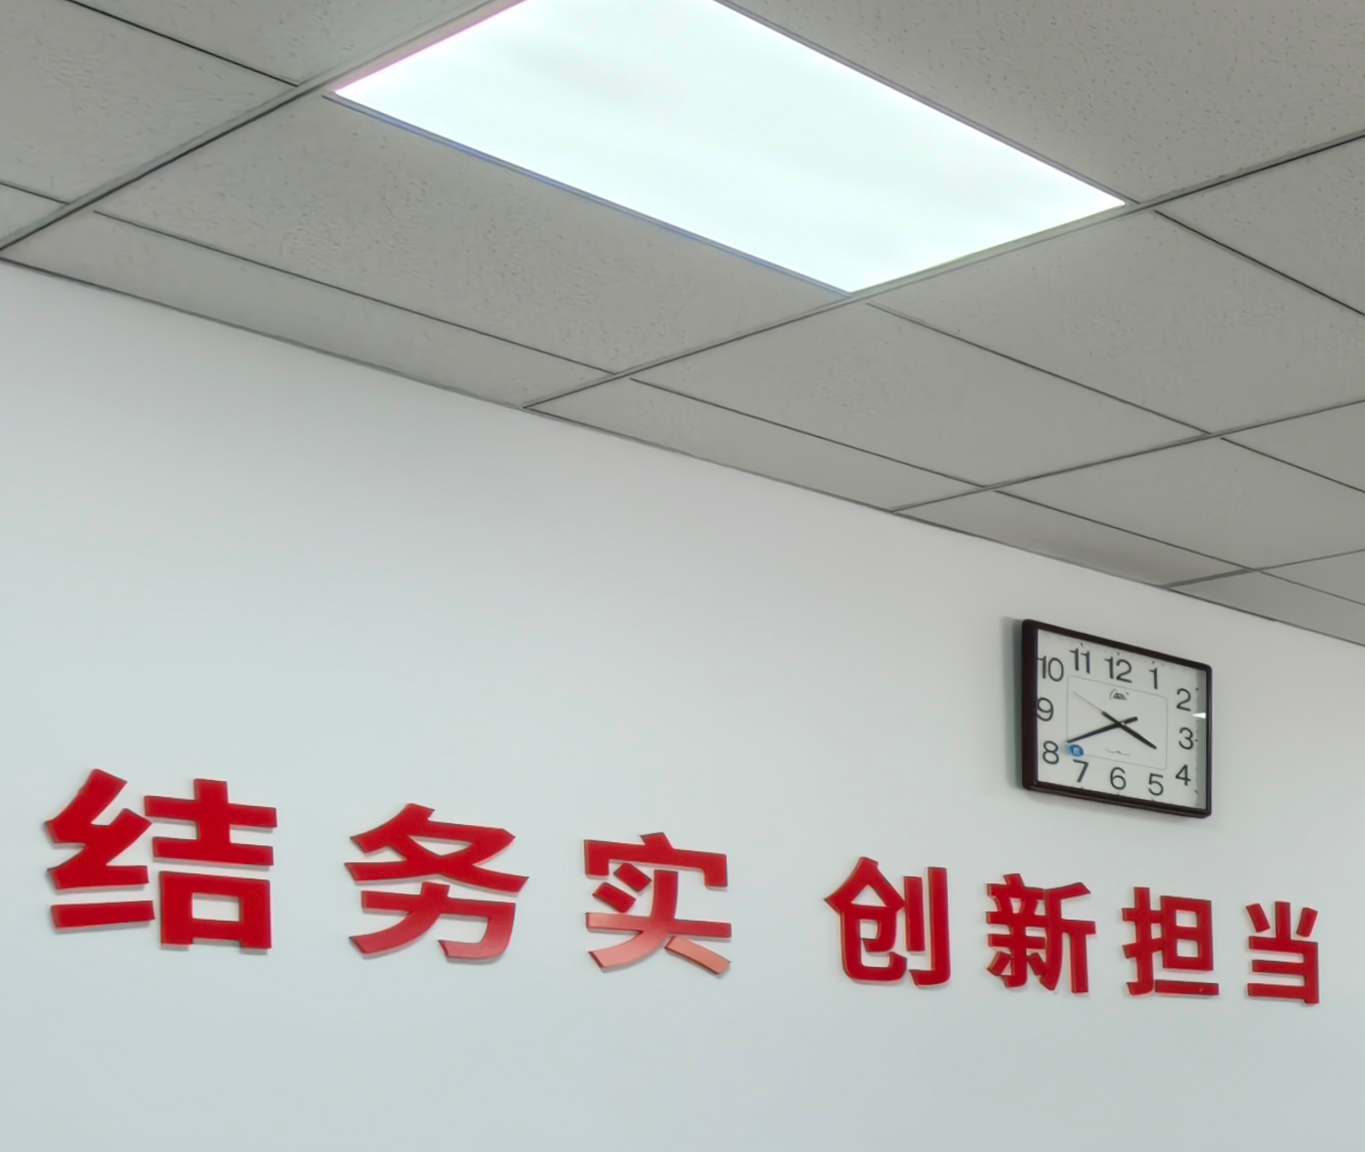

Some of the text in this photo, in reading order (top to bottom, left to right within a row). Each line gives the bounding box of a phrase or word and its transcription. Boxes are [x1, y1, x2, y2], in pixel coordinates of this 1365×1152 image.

[1037, 655, 1064, 682] 10
[1070, 648, 1091, 674] 11
[1104, 656, 1132, 684] 12
[1149, 667, 1159, 690] 1
[1036, 697, 1054, 722] 9
[1176, 688, 1191, 711] 2
[1178, 727, 1194, 750] 3
[1042, 740, 1060, 765] 8
[1072, 759, 1089, 783] 7
[1109, 767, 1127, 790] 6
[1175, 764, 1191, 786] 4
[1148, 773, 1164, 796] 5
[44, 768, 732, 976] 结务实
[823, 856, 1322, 1007] 创新担当
